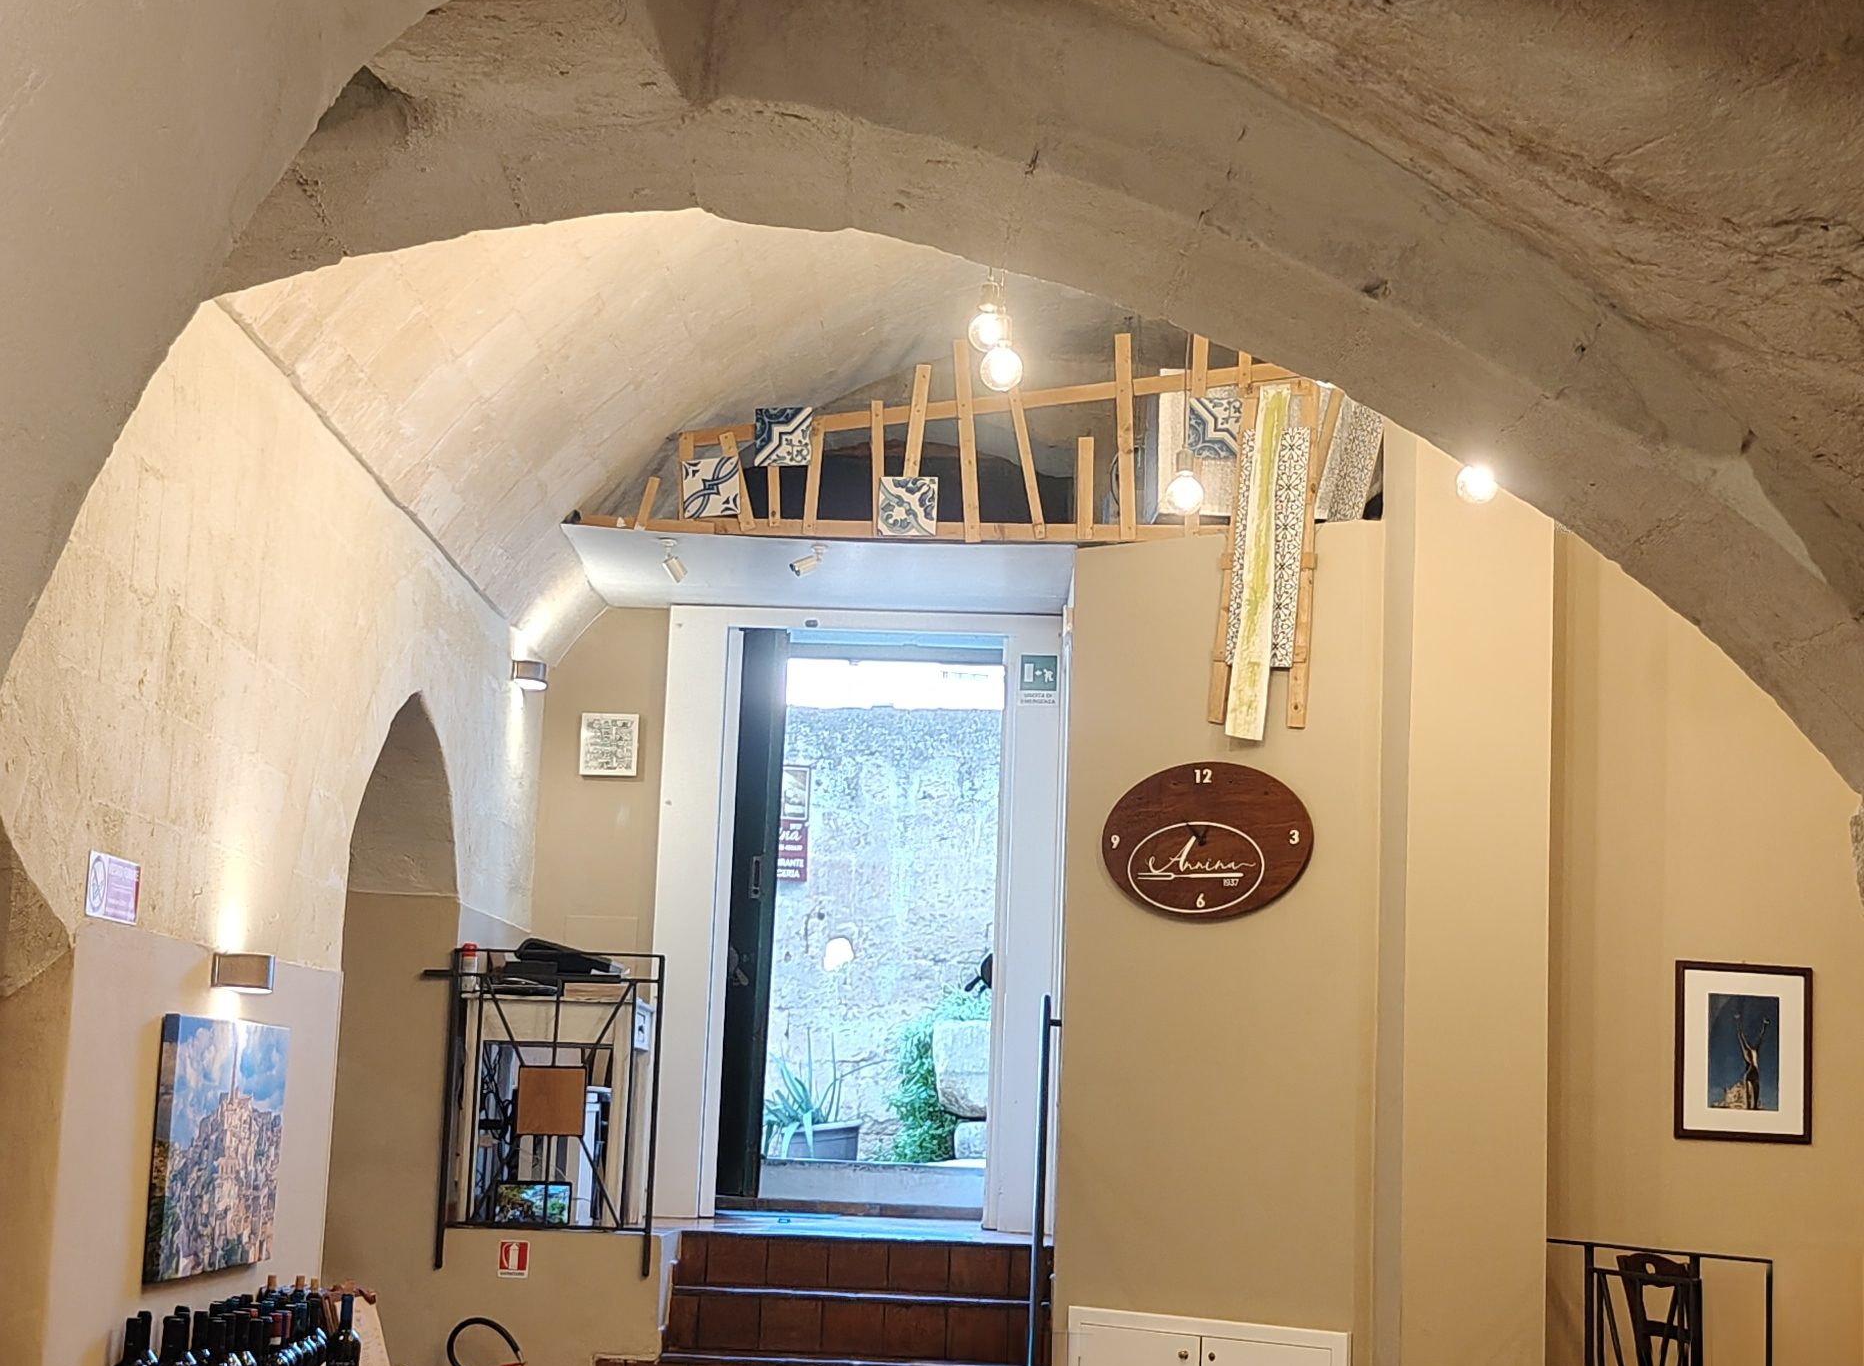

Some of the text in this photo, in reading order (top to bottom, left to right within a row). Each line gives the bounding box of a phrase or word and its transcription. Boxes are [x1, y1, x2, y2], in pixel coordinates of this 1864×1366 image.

[1194, 768, 1213, 784] 12
[1110, 834, 1121, 849] 9
[1288, 829, 1300, 845] 3
[1146, 835, 1256, 873] Annina
[1195, 892, 1206, 908] 6
